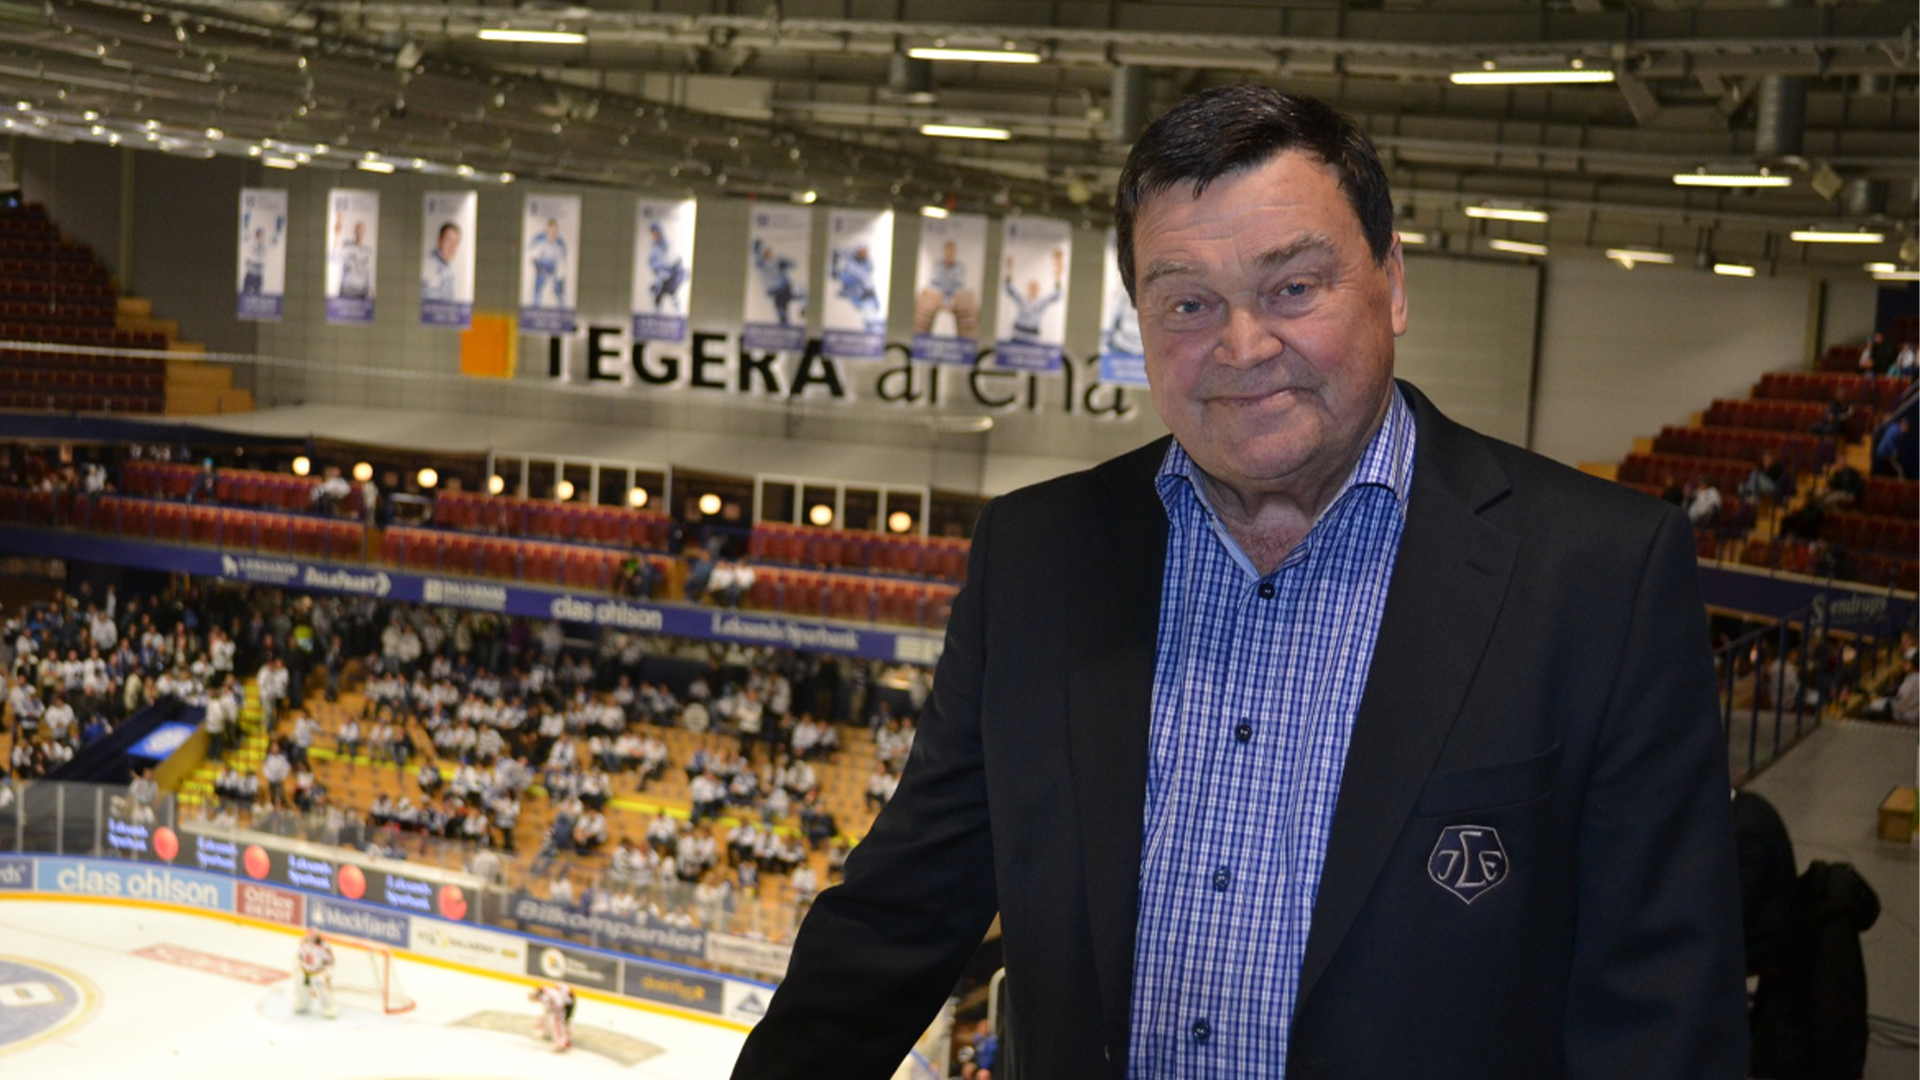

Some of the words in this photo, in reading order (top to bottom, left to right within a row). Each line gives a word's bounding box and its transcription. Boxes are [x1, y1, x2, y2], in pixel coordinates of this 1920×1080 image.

[551, 594, 595, 624] clas
[595, 599, 663, 632] ohlson
[57, 862, 122, 895] clas
[126, 868, 219, 908] ohlson
[244, 885, 294, 909] Office
